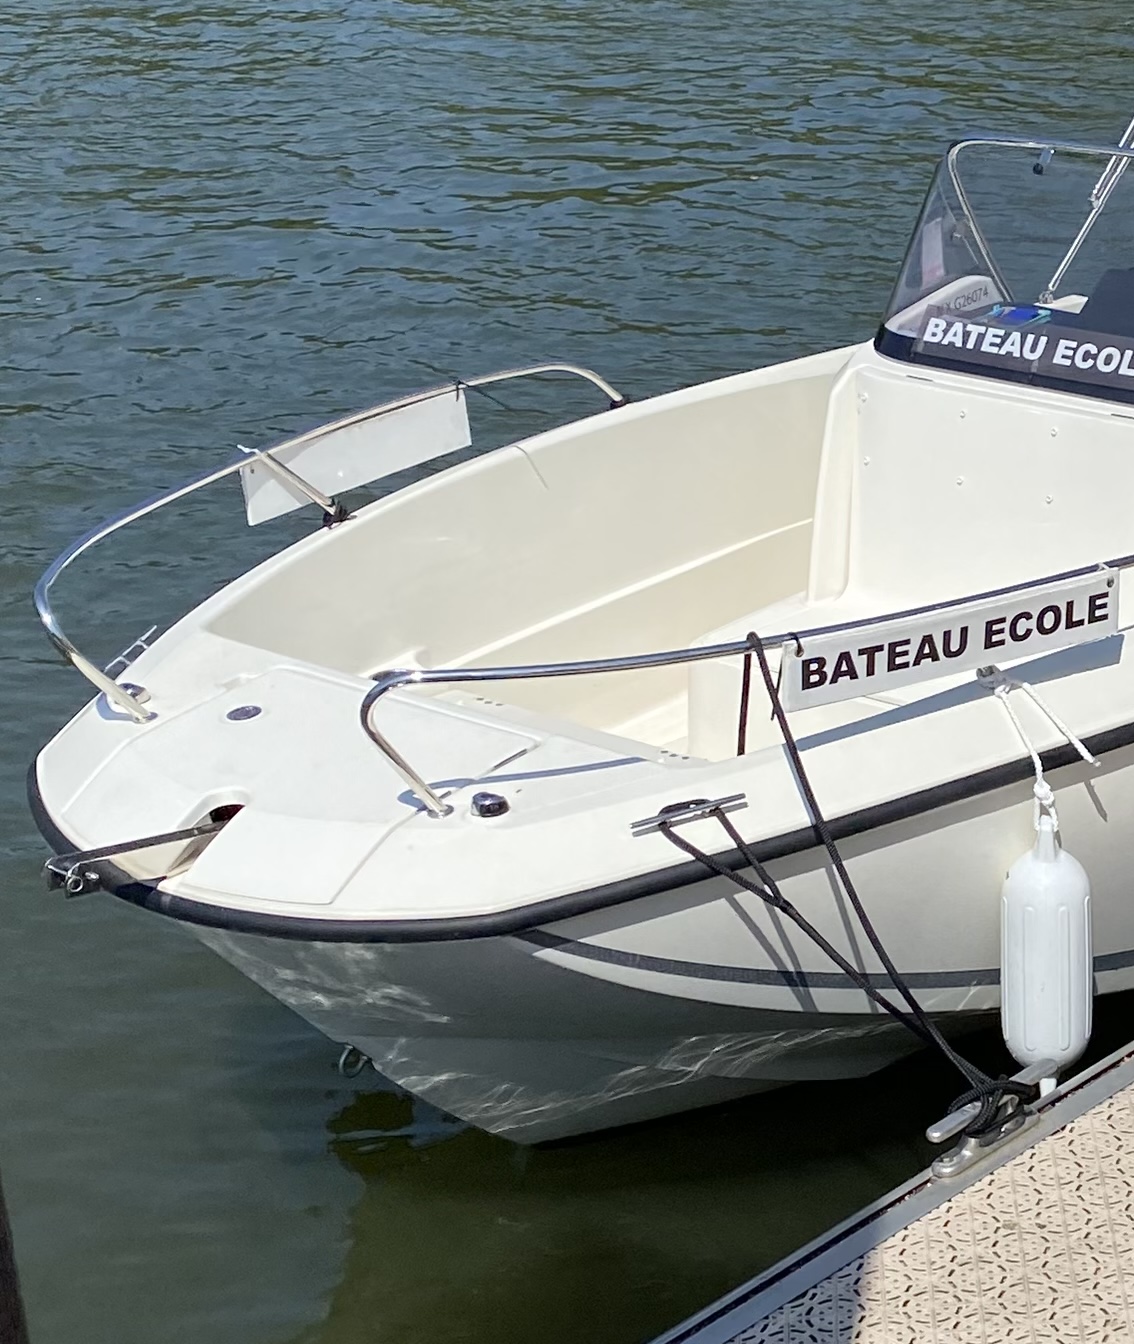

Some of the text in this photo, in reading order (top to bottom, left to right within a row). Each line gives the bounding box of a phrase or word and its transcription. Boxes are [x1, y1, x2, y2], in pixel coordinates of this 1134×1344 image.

[954, 286, 989, 311] G26074
[923, 317, 1049, 361] BATEAU
[800, 591, 1110, 691] BATEAU ECOLE
